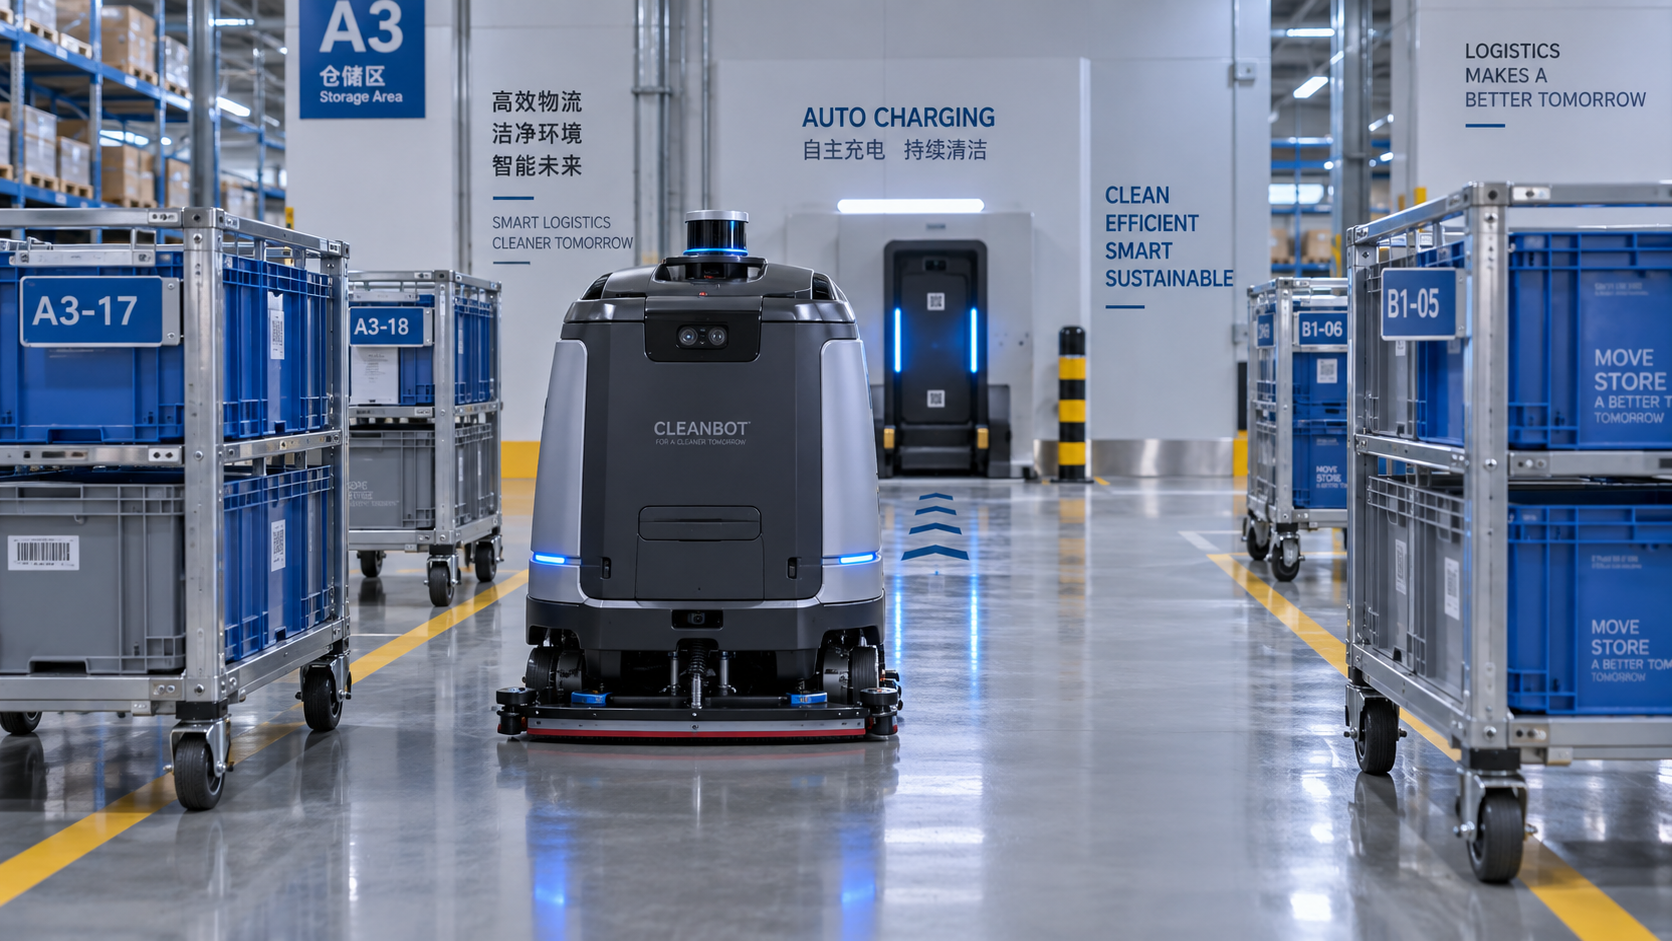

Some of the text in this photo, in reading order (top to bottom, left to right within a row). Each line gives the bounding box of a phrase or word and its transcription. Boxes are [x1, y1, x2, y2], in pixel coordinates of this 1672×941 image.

[319, 0, 404, 53] A3
[1465, 43, 1560, 59] LOGISTICS
[319, 65, 386, 87] 仓储区
[1465, 67, 1548, 83] MAKES A
[320, 90, 403, 106] Storage Area
[492, 90, 582, 113] 高效物流
[1465, 91, 1647, 107] BETTER TOMORROW
[802, 106, 996, 128] AUTO CHARGING
[492, 122, 582, 145] 洁净环境
[803, 138, 988, 161] 自主充电 持续清洁
[492, 154, 582, 177] 智能未来
[1105, 186, 1170, 204] CLEAN
[492, 216, 611, 229] SMART LOGISTICS
[1105, 214, 1200, 232] EFFICIENT
[492, 236, 634, 250] CLEANER TOMORROW
[1105, 241, 1173, 260] SMART
[1105, 269, 1234, 287] SUSTAINABLE
[32, 295, 138, 326] A3-17
[1387, 288, 1440, 319] B1-05
[353, 317, 409, 336] A3-18
[1302, 321, 1343, 338] B1-06
[1594, 348, 1654, 367] MOVE
[1594, 372, 1667, 392] STORE
[1594, 395, 1605, 409] A
[1608, 395, 1661, 409] BETTER
[1591, 619, 1640, 635] MOVE
[1591, 639, 1650, 655] STORE
[1591, 659, 1600, 670] A
[1602, 659, 1644, 670] BETTER
